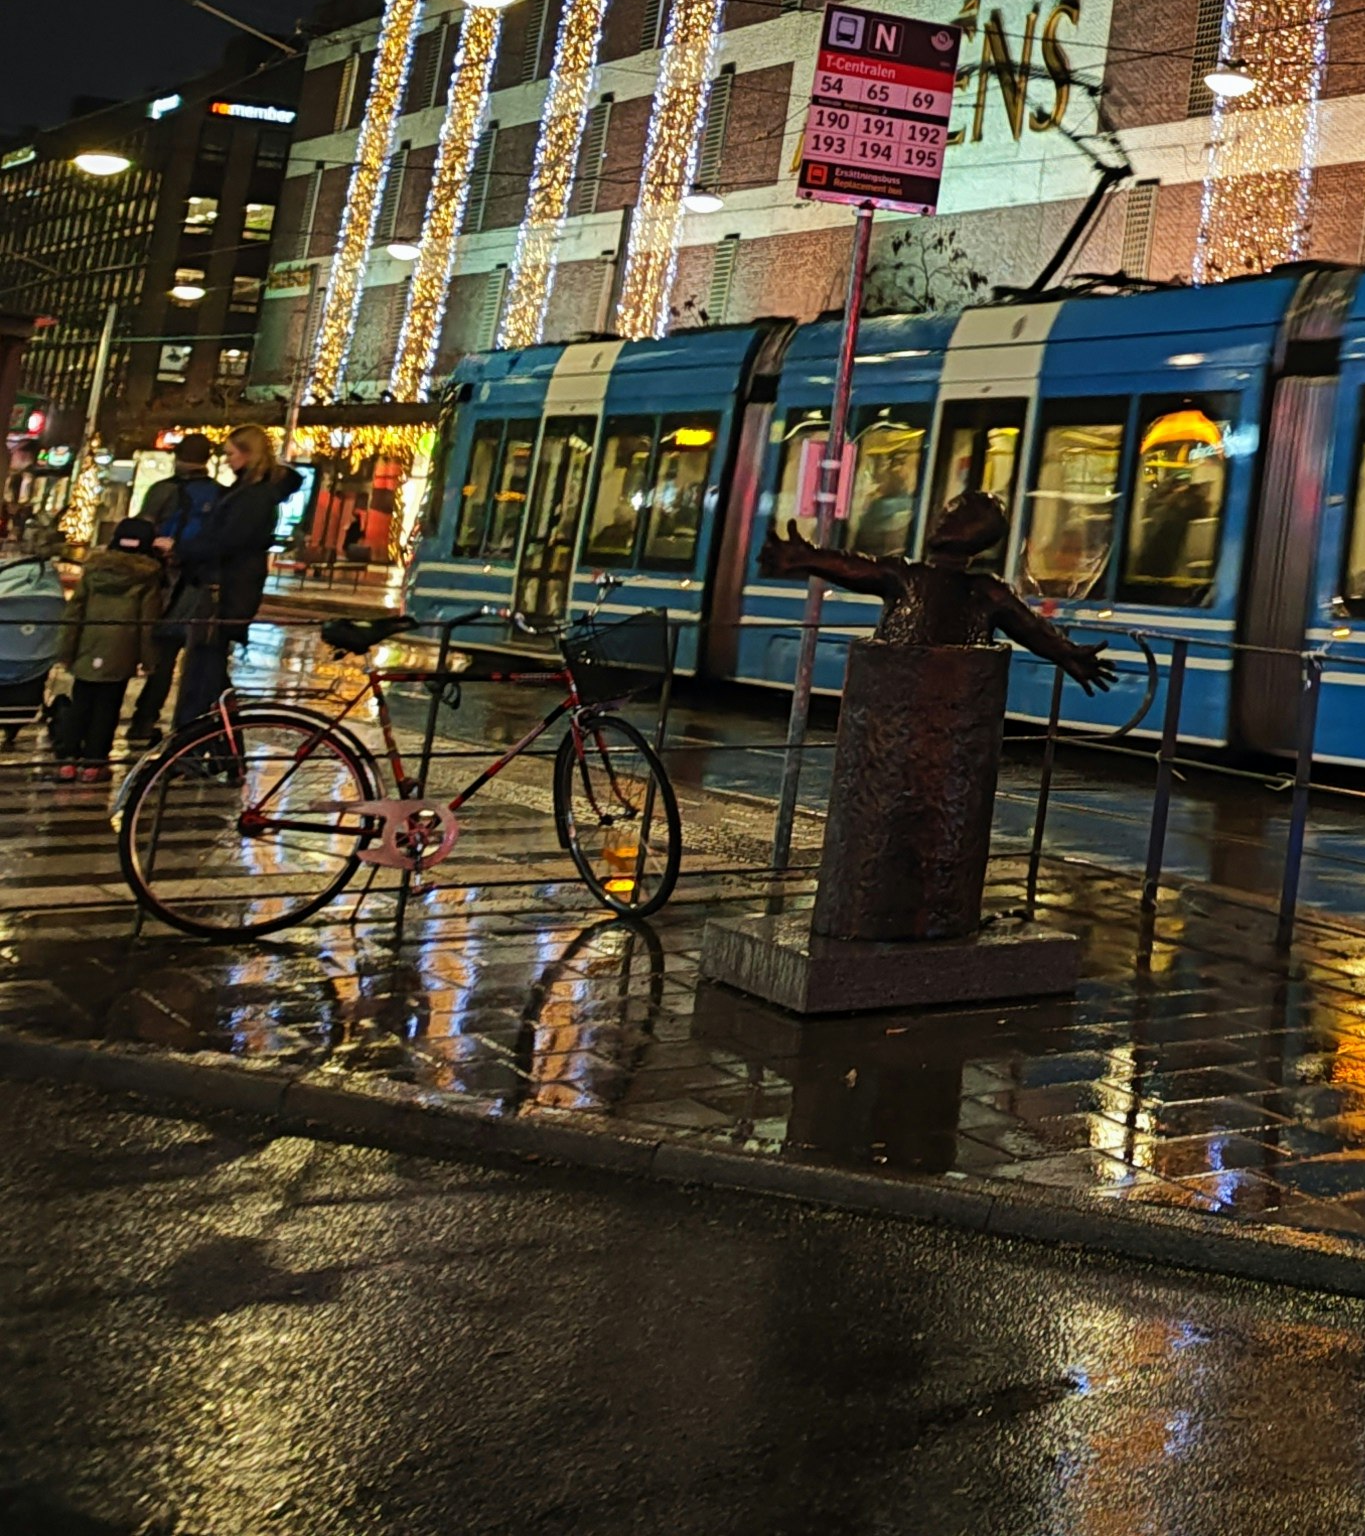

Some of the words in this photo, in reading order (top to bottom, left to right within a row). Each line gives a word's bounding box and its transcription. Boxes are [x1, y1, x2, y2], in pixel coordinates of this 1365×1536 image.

[875, 22, 897, 53] N
[825, 54, 897, 80] T-Centralen
[820, 75, 844, 95] 54
[866, 83, 890, 103] 65
[912, 91, 935, 110] 69
[815, 109, 850, 130] 190
[862, 117, 895, 138] 191
[907, 124, 941, 145] 192
[811, 133, 847, 154] 193
[858, 140, 893, 162] 194
[904, 147, 938, 168] 195
[834, 166, 902, 185] Ersättningsbuss
